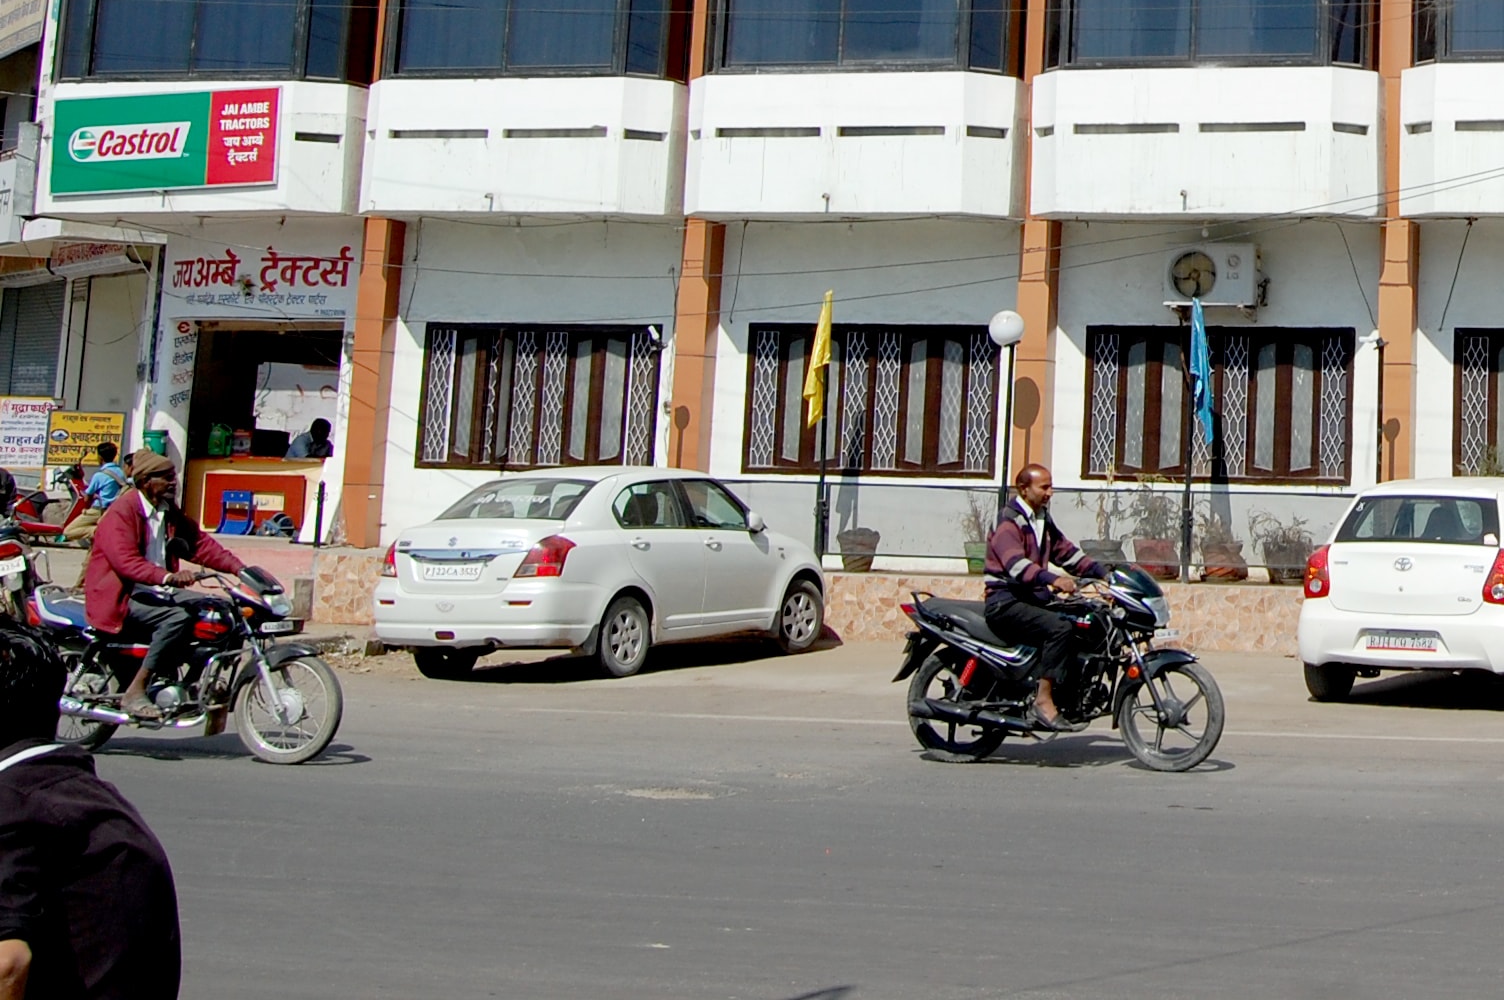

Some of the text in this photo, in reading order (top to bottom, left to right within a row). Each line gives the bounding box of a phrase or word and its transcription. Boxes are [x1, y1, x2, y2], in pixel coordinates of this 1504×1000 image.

[221, 102, 270, 115] JAI AMBE
[220, 117, 270, 130] TRACTORS
[98, 126, 181, 157] Castrol
[222, 136, 241, 147] जय
